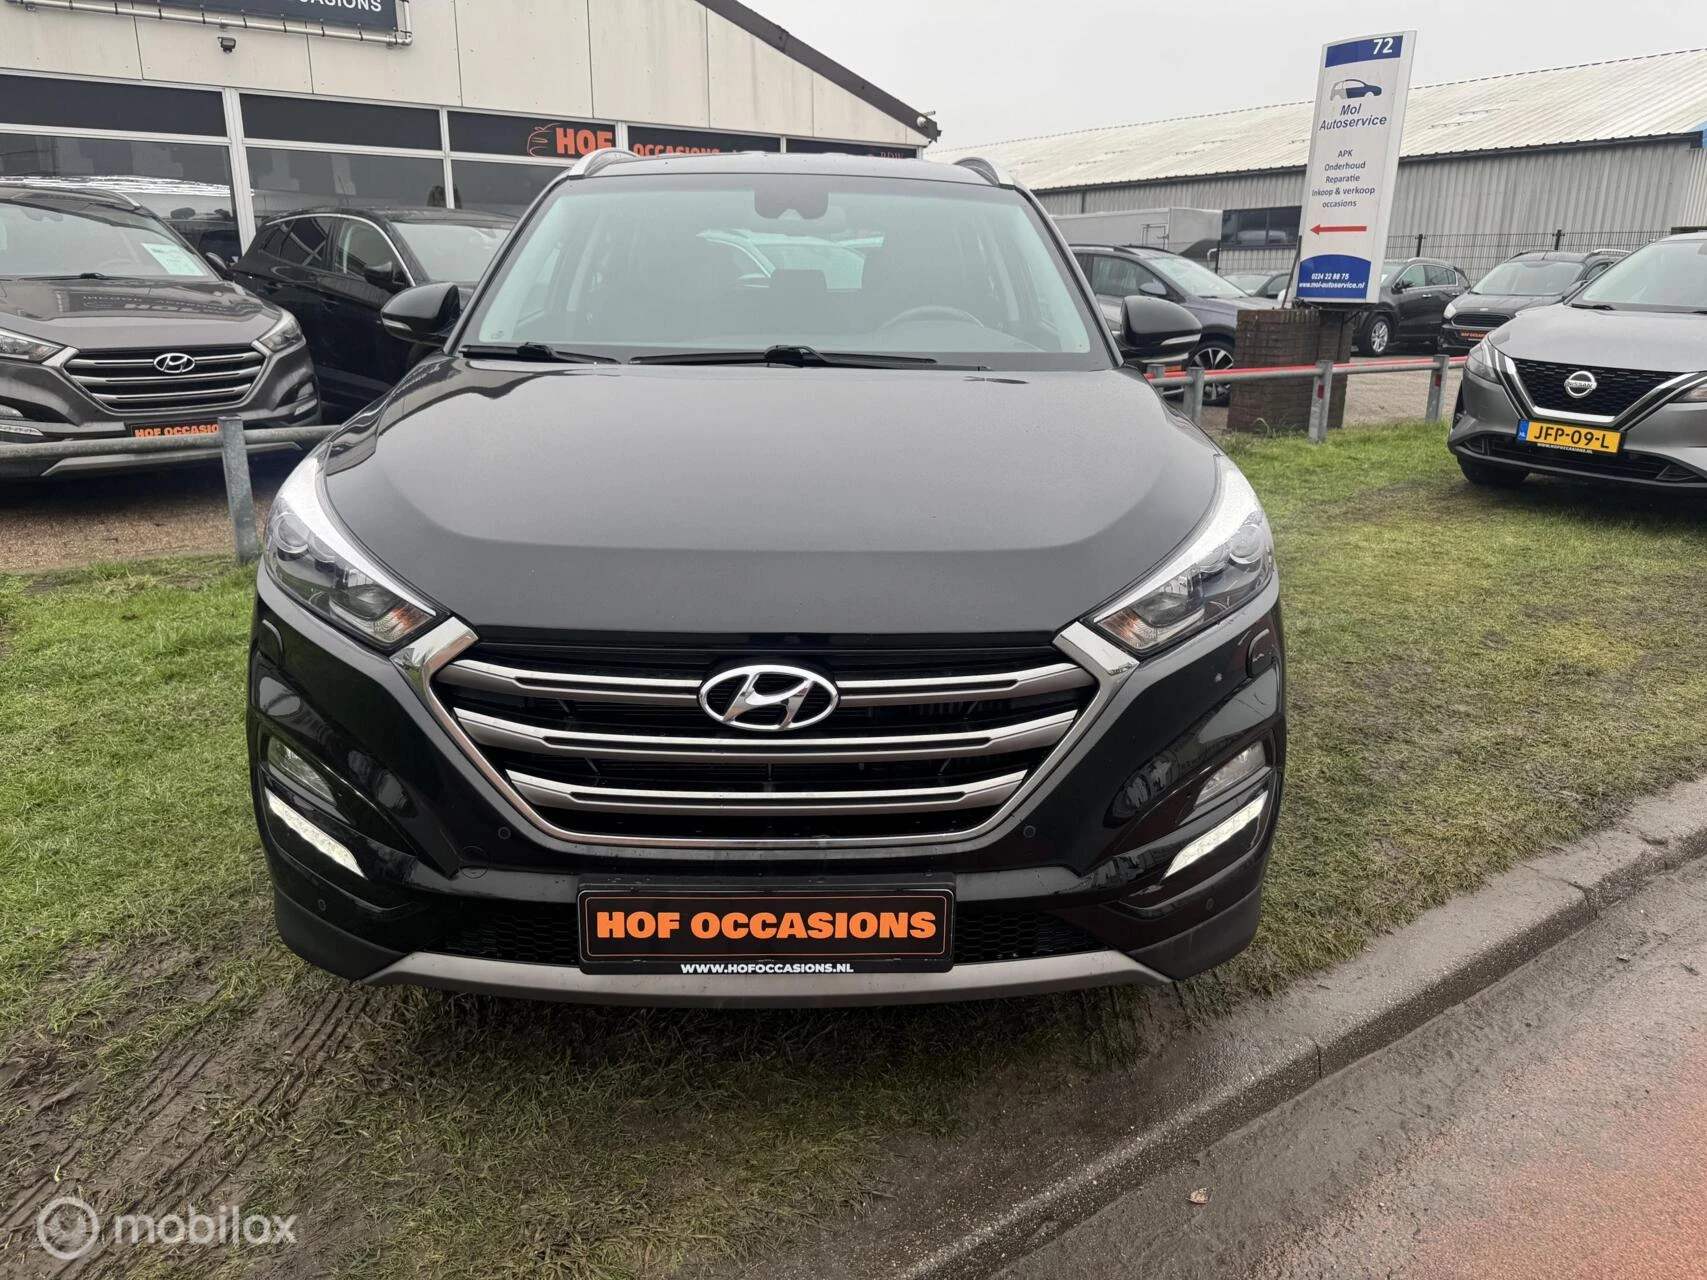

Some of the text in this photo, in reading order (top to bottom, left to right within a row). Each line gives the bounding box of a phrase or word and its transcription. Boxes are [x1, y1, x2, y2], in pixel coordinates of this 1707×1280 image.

[1373, 37, 1394, 55] 72
[1340, 103, 1362, 117] Mol
[1319, 115, 1387, 131] Autoservice
[555, 127, 614, 154] HOF
[1337, 149, 1353, 158] APK
[1324, 161, 1366, 171] Onderhoud
[1326, 173, 1361, 184] Reparatie
[1312, 186, 1376, 197] Inkoop & verkoop
[1322, 200, 1357, 208] occasions
[1325, 272, 1332, 280] 22
[1299, 281, 1365, 289] www.mol-autoservice.nl
[134, 428, 161, 438] HOF
[1534, 425, 1610, 449] JFP-09-L
[596, 911, 937, 940] HOF OCCASIONS
[680, 962, 854, 974] WWW.HOFOCCASIONS.NL
